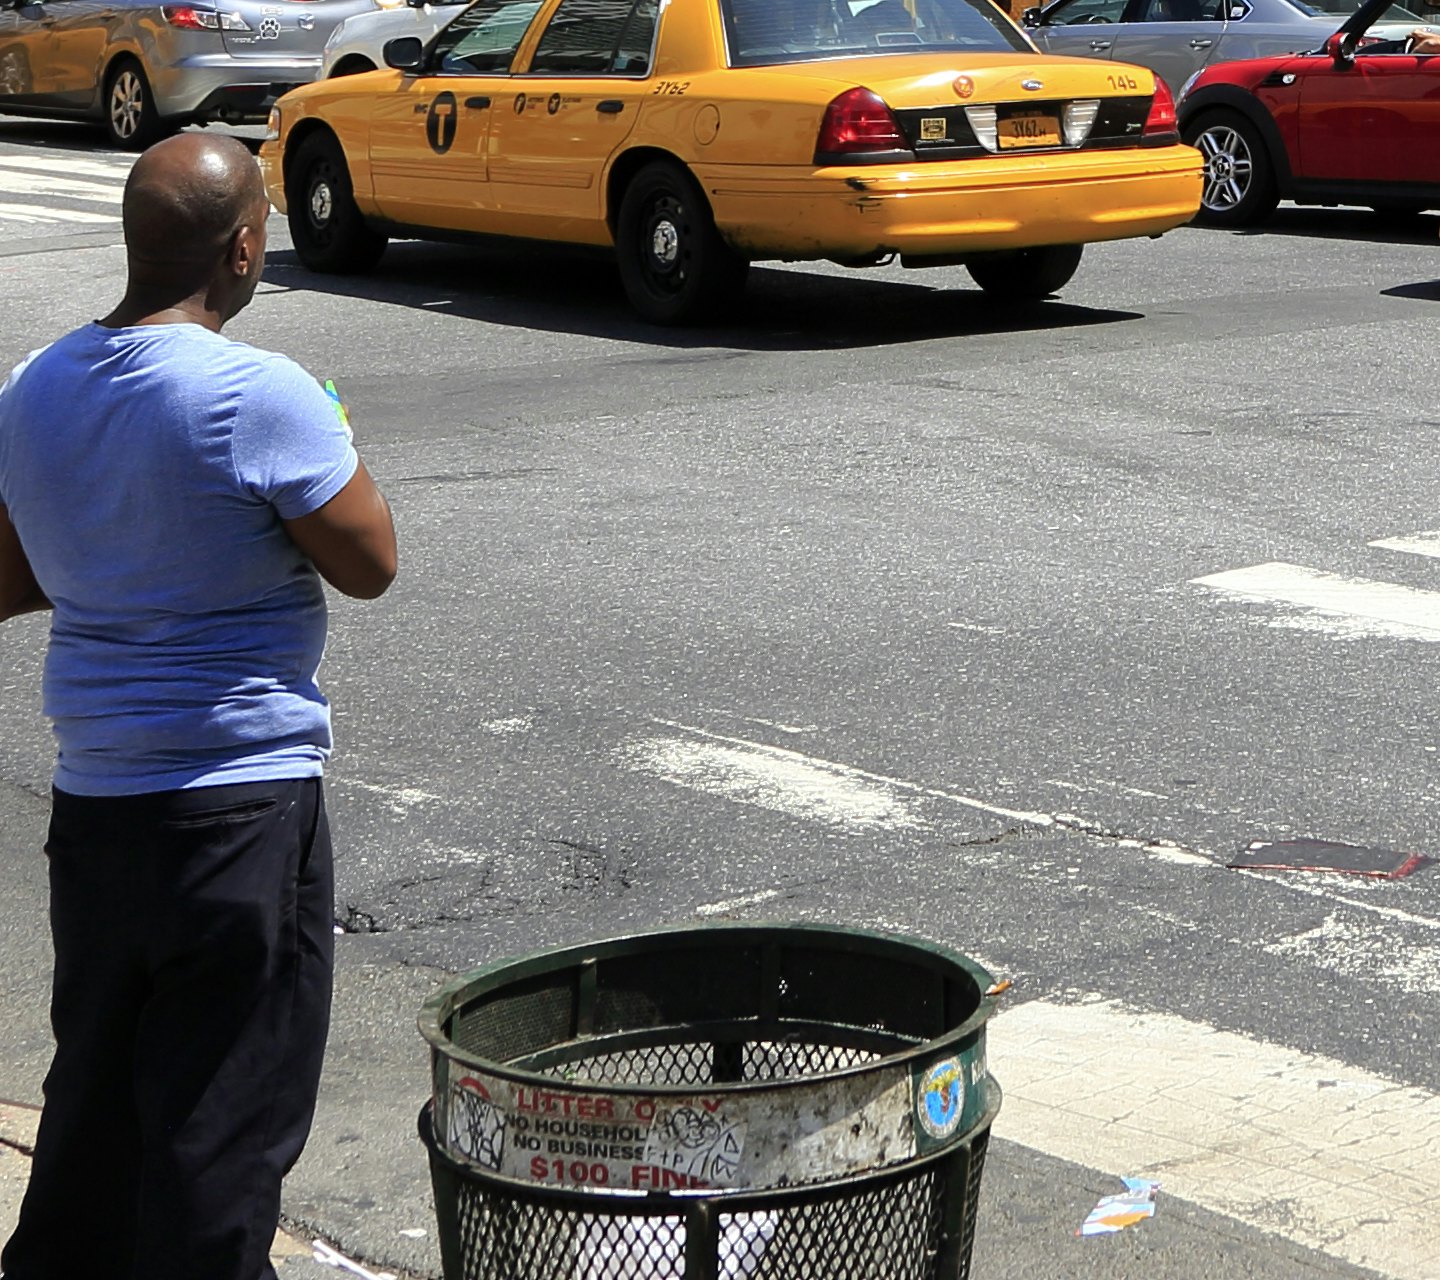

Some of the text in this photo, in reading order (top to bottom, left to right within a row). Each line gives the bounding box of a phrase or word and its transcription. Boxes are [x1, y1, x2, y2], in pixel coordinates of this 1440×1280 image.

[516, 1087, 615, 1119] LITTER
[505, 1114, 650, 1140] NO HOUSEHOL
[512, 1134, 542, 1152] NO
[530, 1156, 610, 1186] $100
